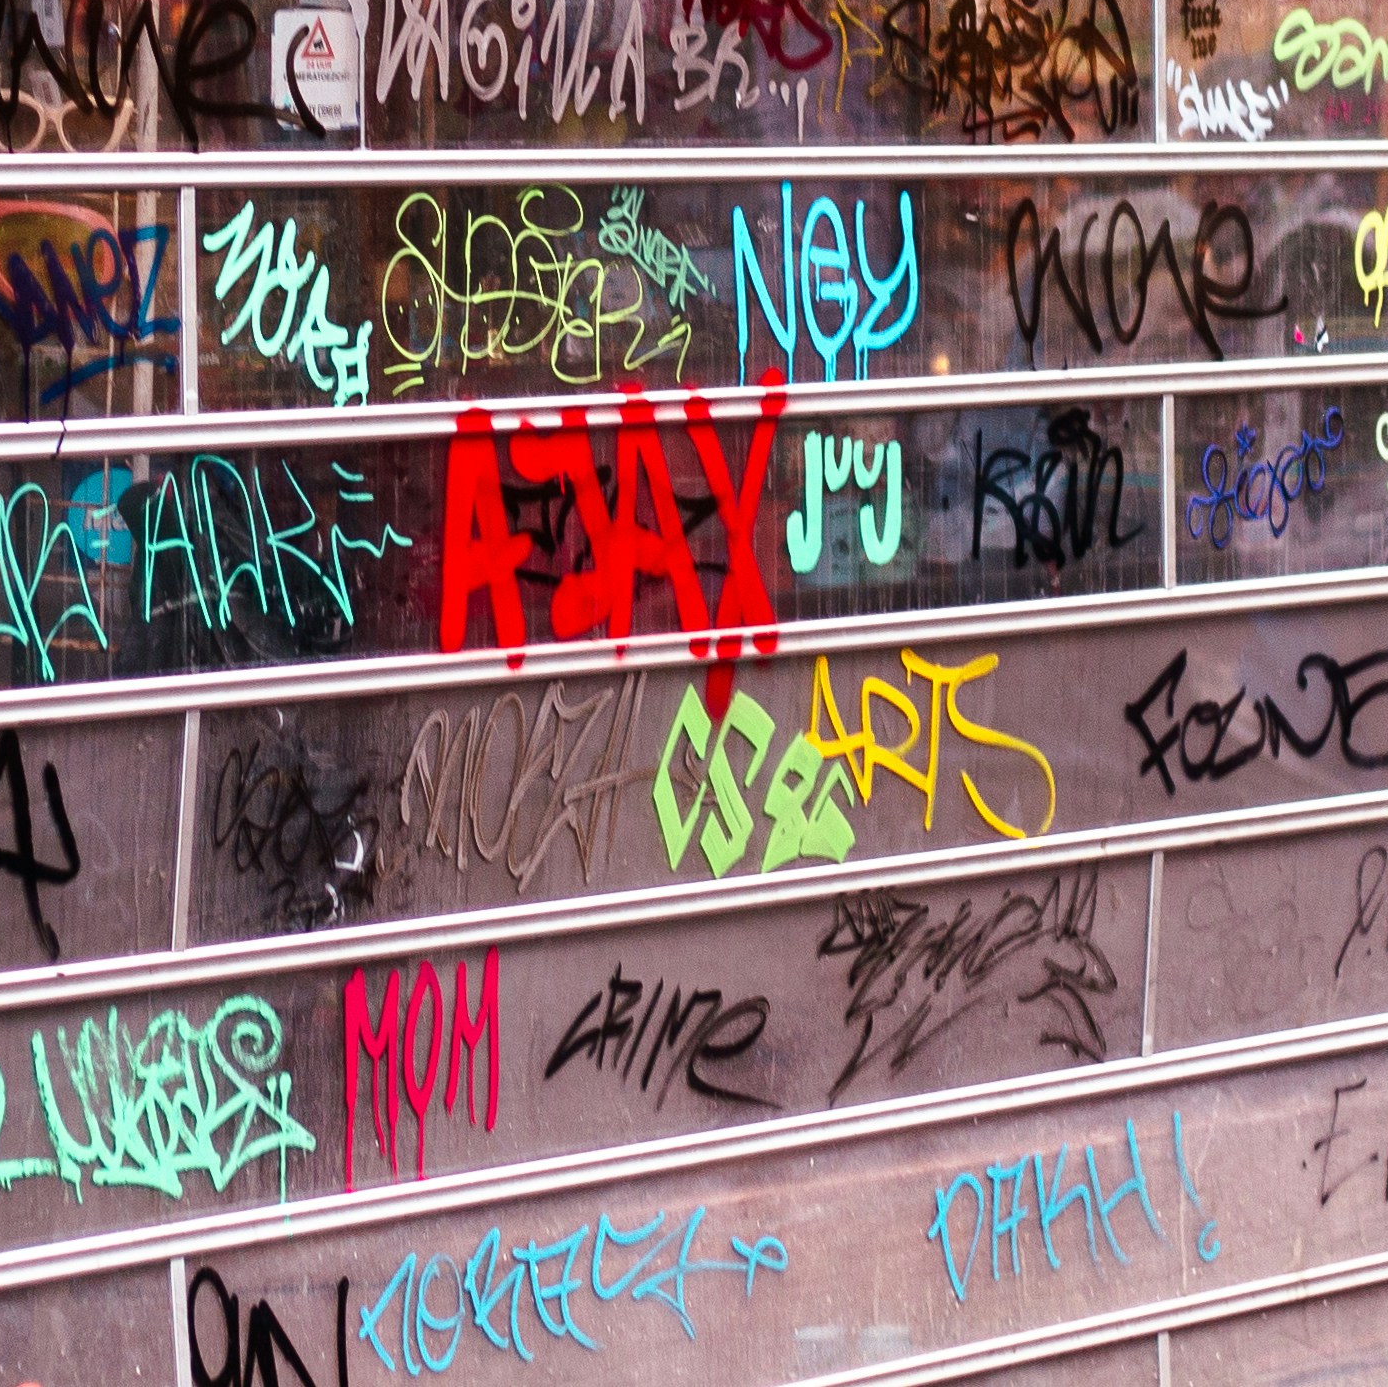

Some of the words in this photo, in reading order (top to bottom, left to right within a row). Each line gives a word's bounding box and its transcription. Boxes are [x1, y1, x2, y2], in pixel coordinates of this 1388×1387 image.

[440, 369, 787, 664] AJAX
[806, 647, 1056, 842] ARTS
[344, 944, 501, 1194] MOM
